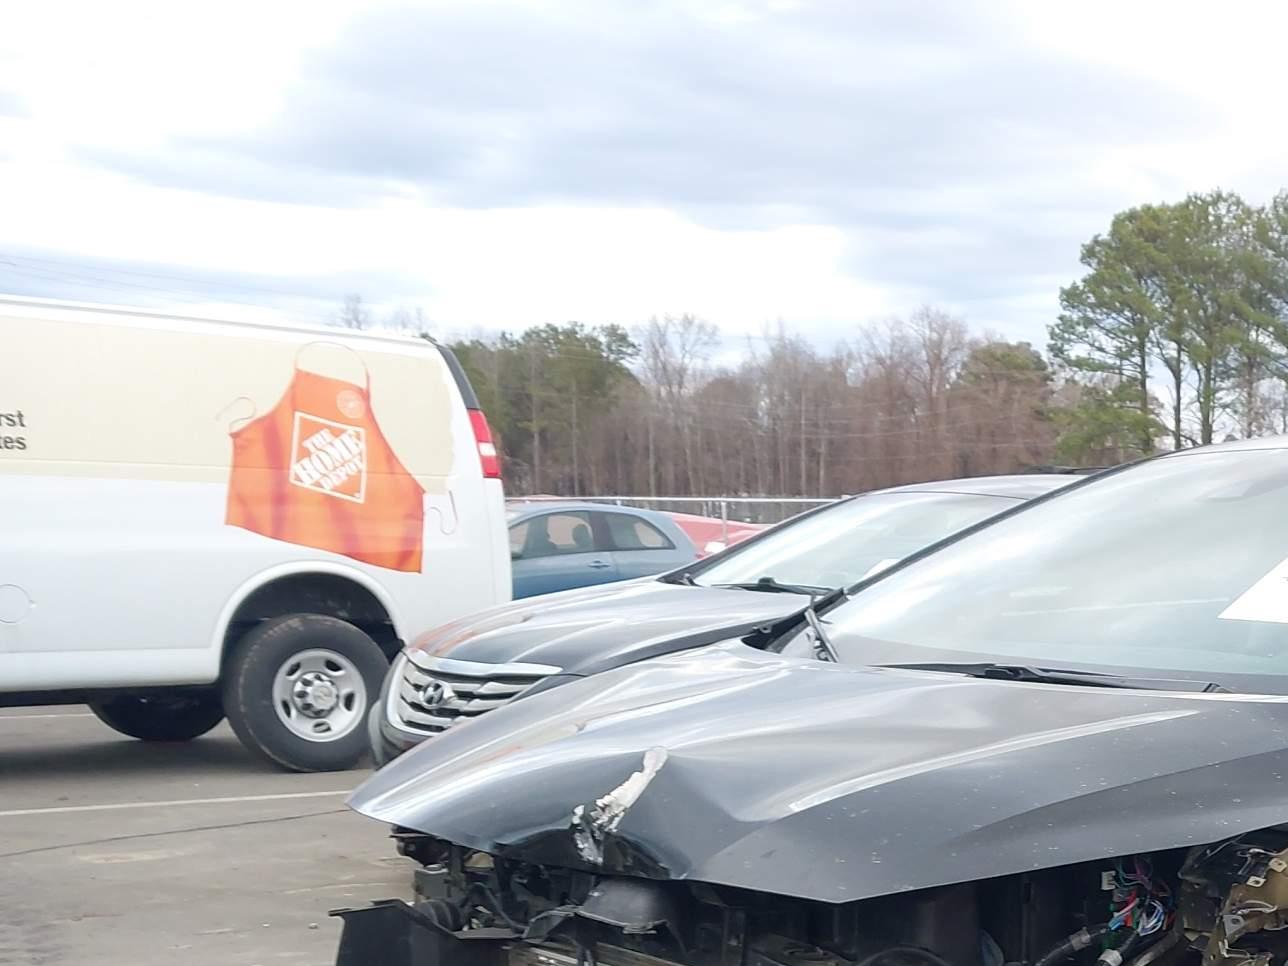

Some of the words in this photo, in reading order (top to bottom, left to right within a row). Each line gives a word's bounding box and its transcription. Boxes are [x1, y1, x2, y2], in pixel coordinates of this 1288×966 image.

[294, 430, 362, 485] HOME
[302, 428, 337, 453] THE
[319, 456, 363, 490] DEPOT
